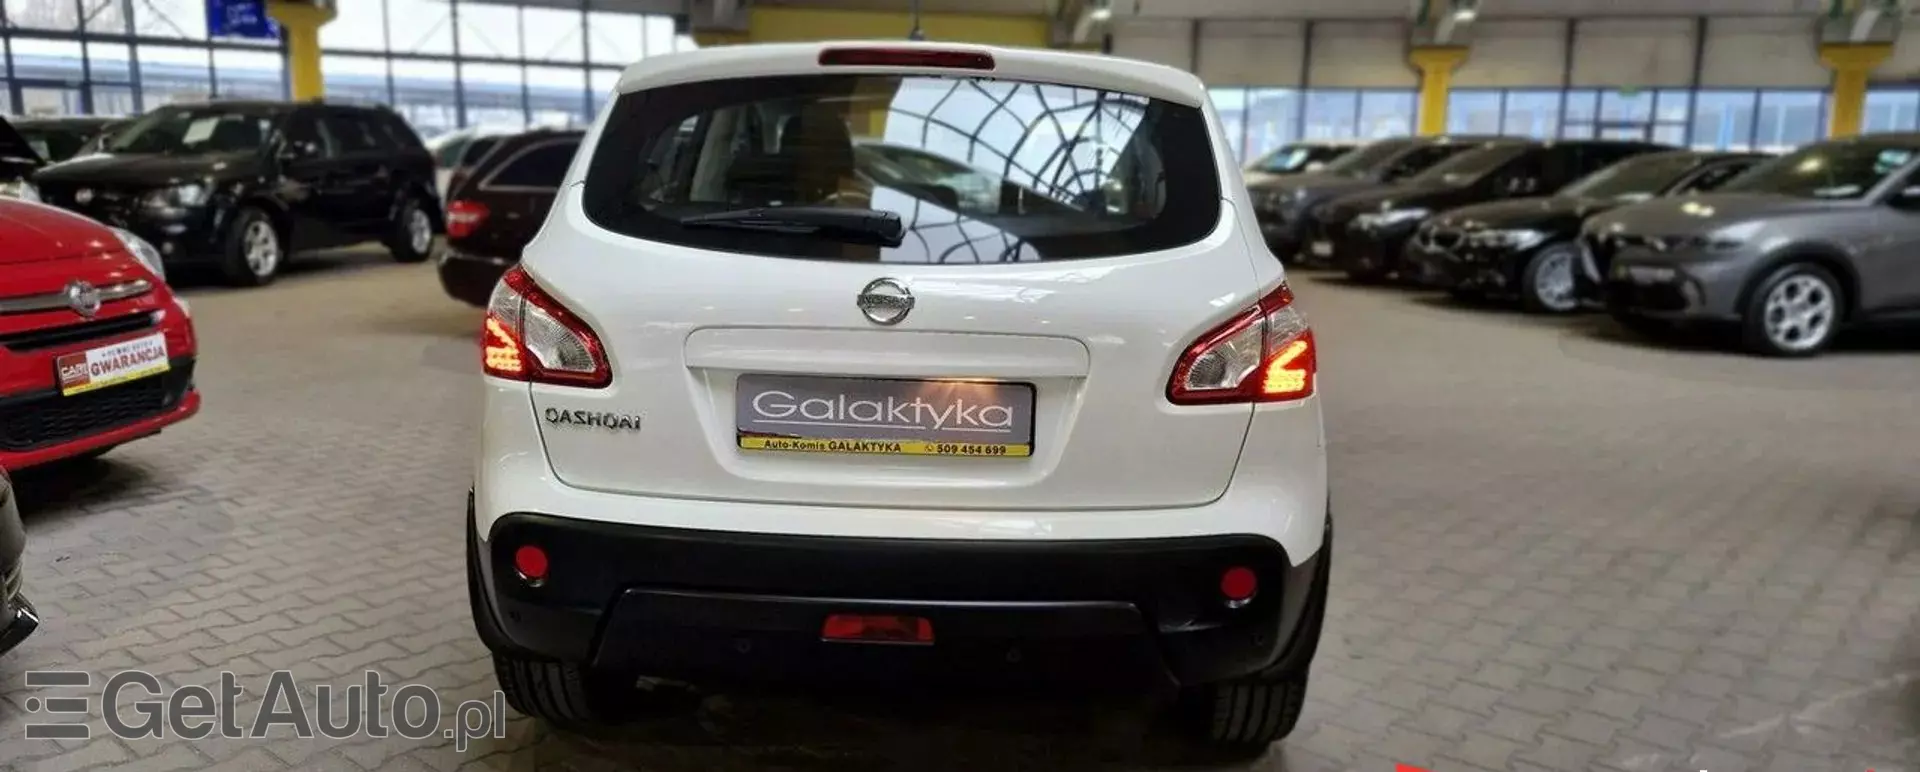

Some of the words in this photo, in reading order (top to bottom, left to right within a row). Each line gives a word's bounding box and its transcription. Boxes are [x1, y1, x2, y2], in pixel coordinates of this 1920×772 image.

[91, 345, 165, 377] GWARANCJA
[544, 407, 641, 430] QASHQAI
[751, 390, 1013, 430] Galaktyka
[763, 439, 826, 451] Auto-Komis
[828, 440, 902, 452] GALAKTYKA
[936, 444, 958, 455] 509
[960, 445, 982, 455] 454
[985, 445, 1007, 456] 699
